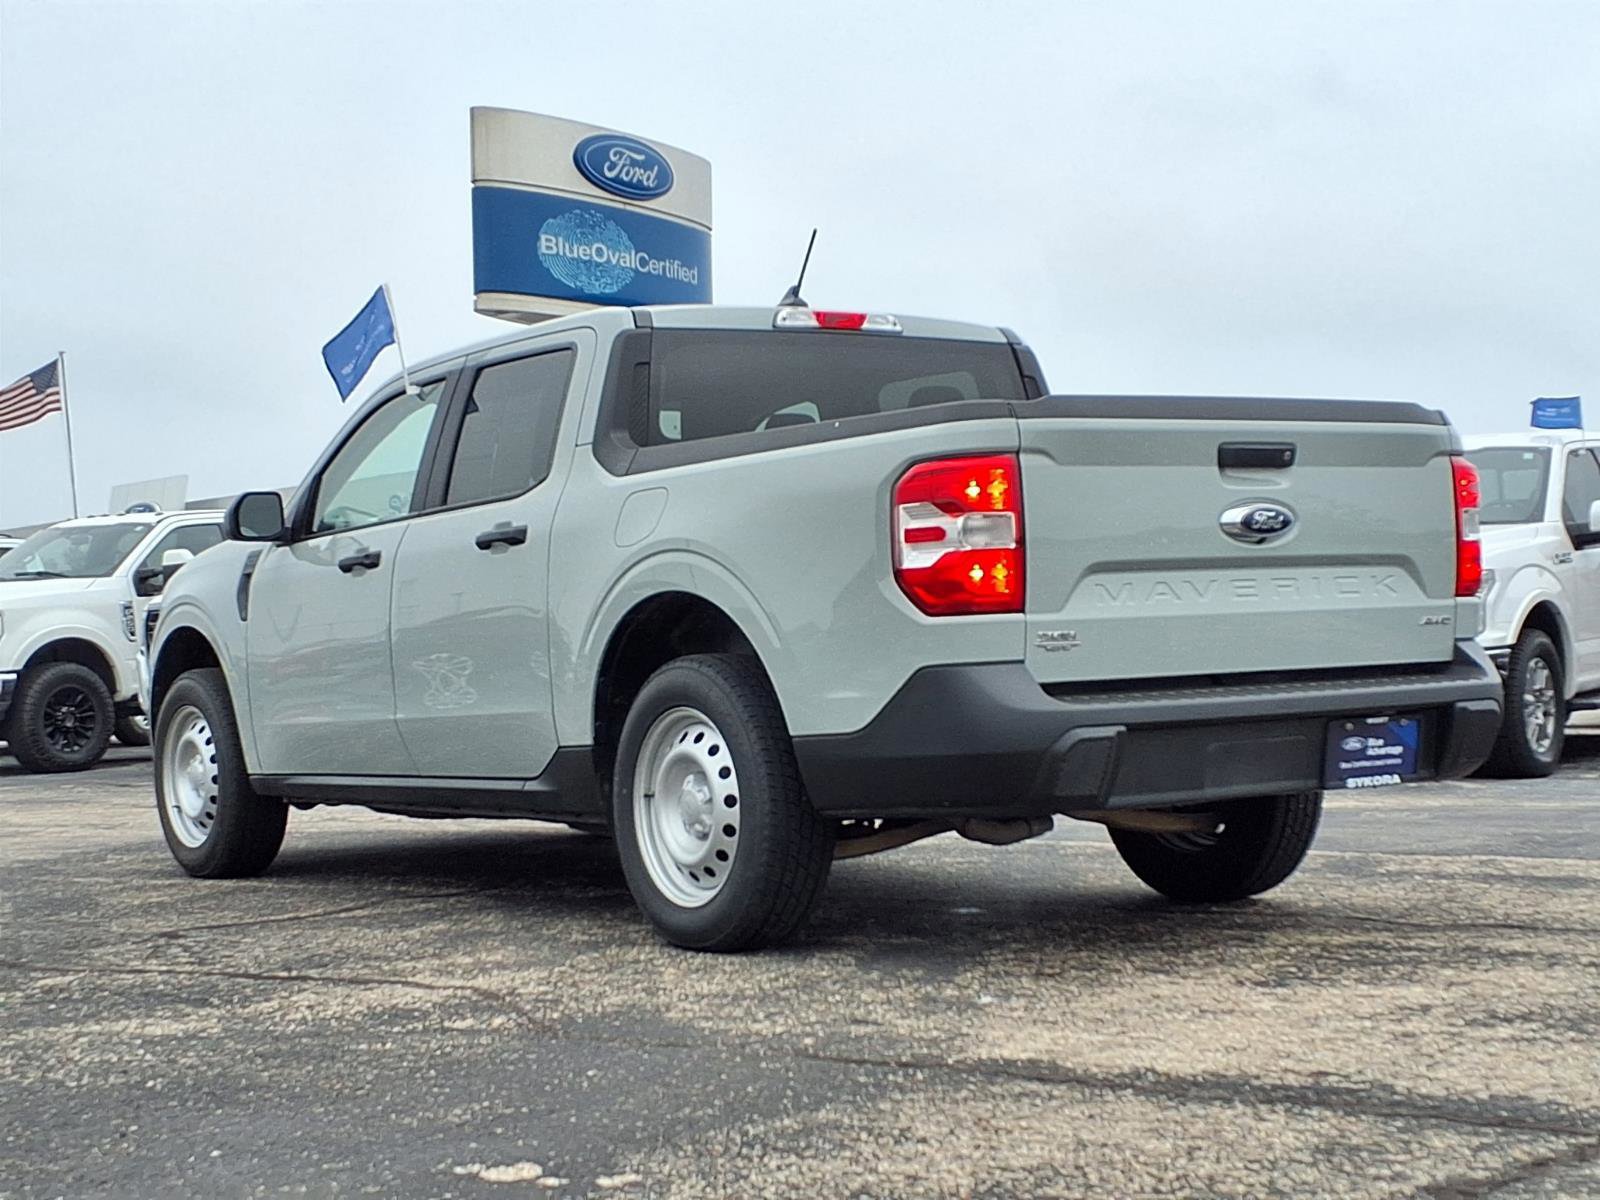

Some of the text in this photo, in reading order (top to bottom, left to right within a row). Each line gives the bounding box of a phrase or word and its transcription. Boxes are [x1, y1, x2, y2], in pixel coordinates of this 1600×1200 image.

[603, 147, 658, 188] Ford
[1249, 510, 1284, 529] Ford
[1094, 575, 1398, 606] MAVERICK
